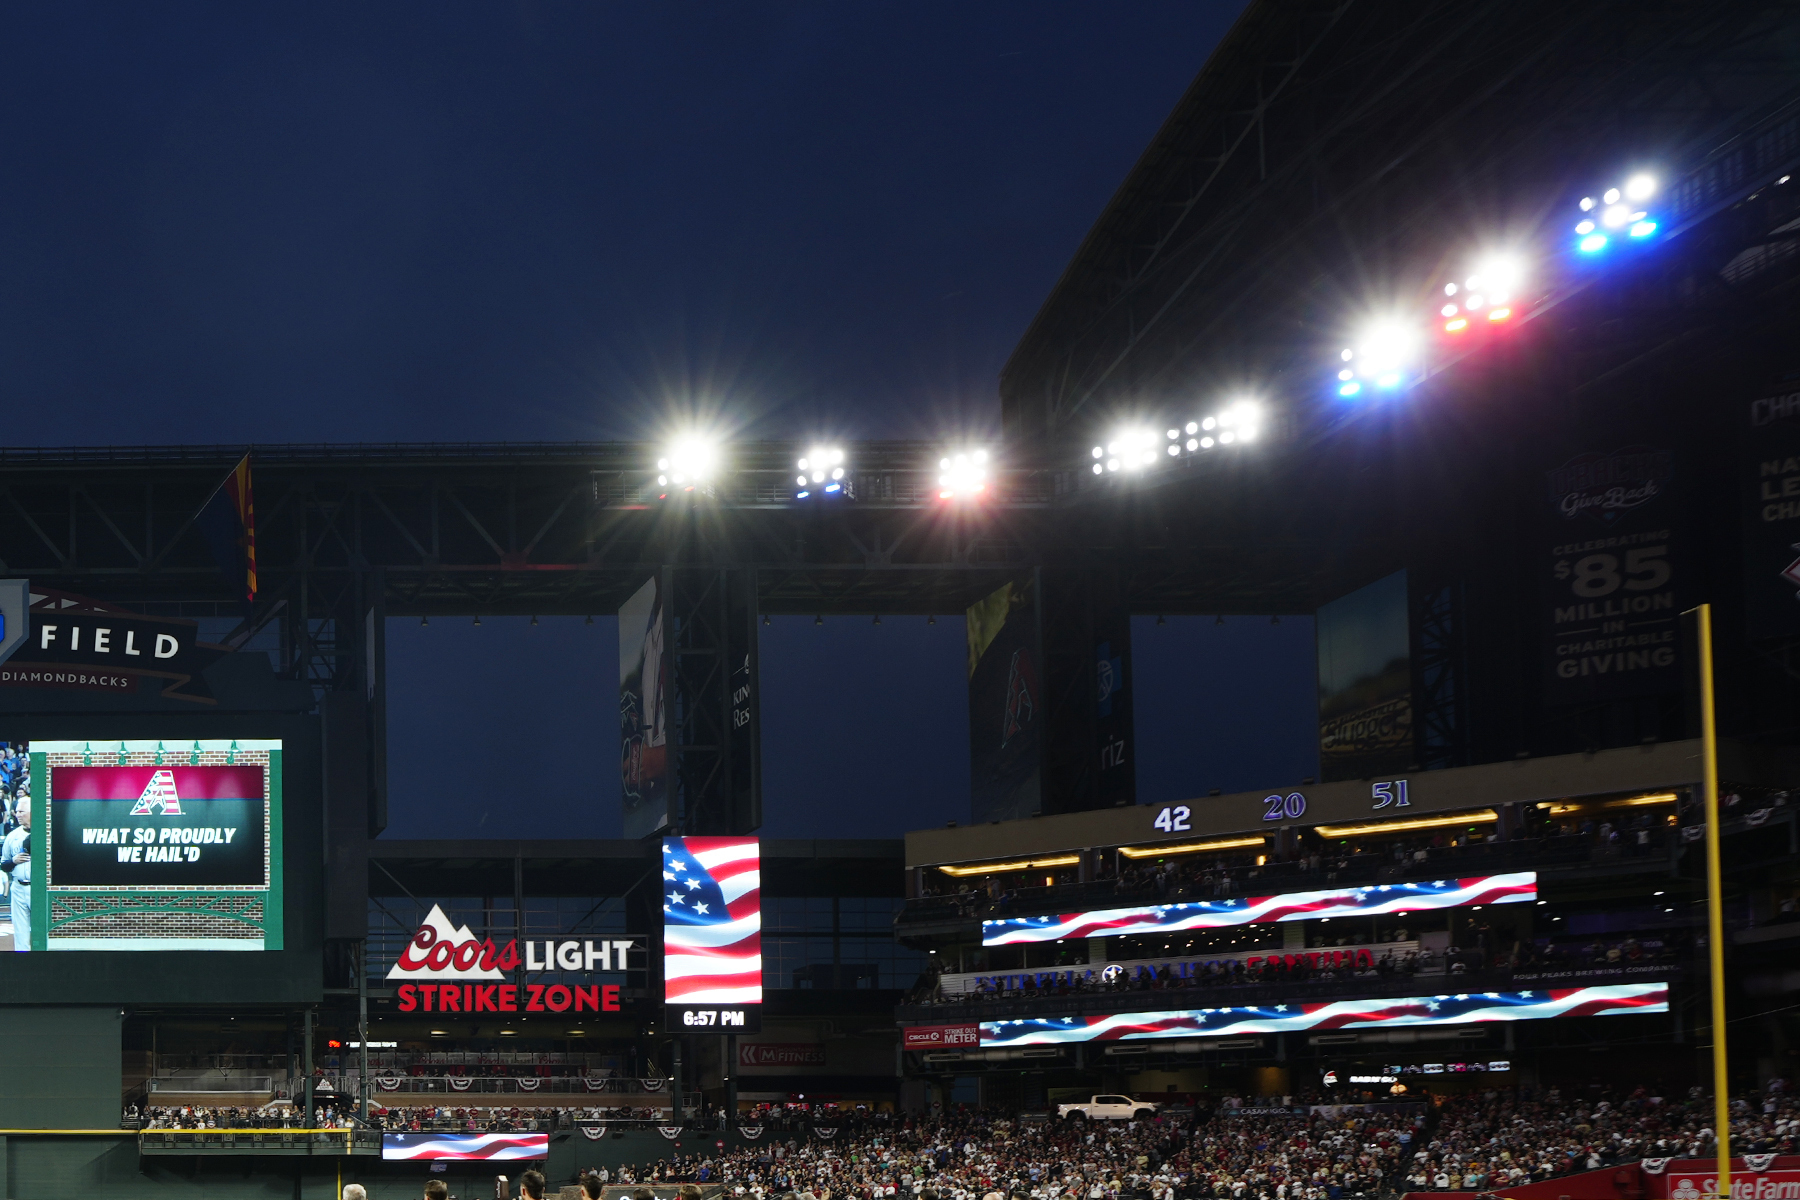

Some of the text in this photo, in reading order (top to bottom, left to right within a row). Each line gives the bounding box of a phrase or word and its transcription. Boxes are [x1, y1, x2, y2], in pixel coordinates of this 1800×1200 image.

[1552, 529, 1670, 556] CELEBRATING
[1555, 592, 1675, 624] MILLION
[1603, 620, 1625, 633] IN
[40, 624, 179, 660] FIELD
[1556, 630, 1675, 656] CHARITABLE
[1556, 646, 1677, 679] GIVING
[2, 670, 129, 688] DIAMONDBACKS
[1154, 780, 1411, 832] 42 20 51
[82, 827, 237, 844] WHAT SO PROUDLY
[117, 846, 201, 863] WE HAIL'D
[398, 924, 635, 971] Coors LIGHT
[1541, 971, 1572, 979] PEAKS
[1575, 967, 1622, 977] BREWING
[398, 984, 620, 1012] STRIKE ZONE
[683, 1011, 745, 1026] 6:57 PM
[944, 1033, 977, 1044] METER
[779, 1052, 825, 1062] FITNESS
